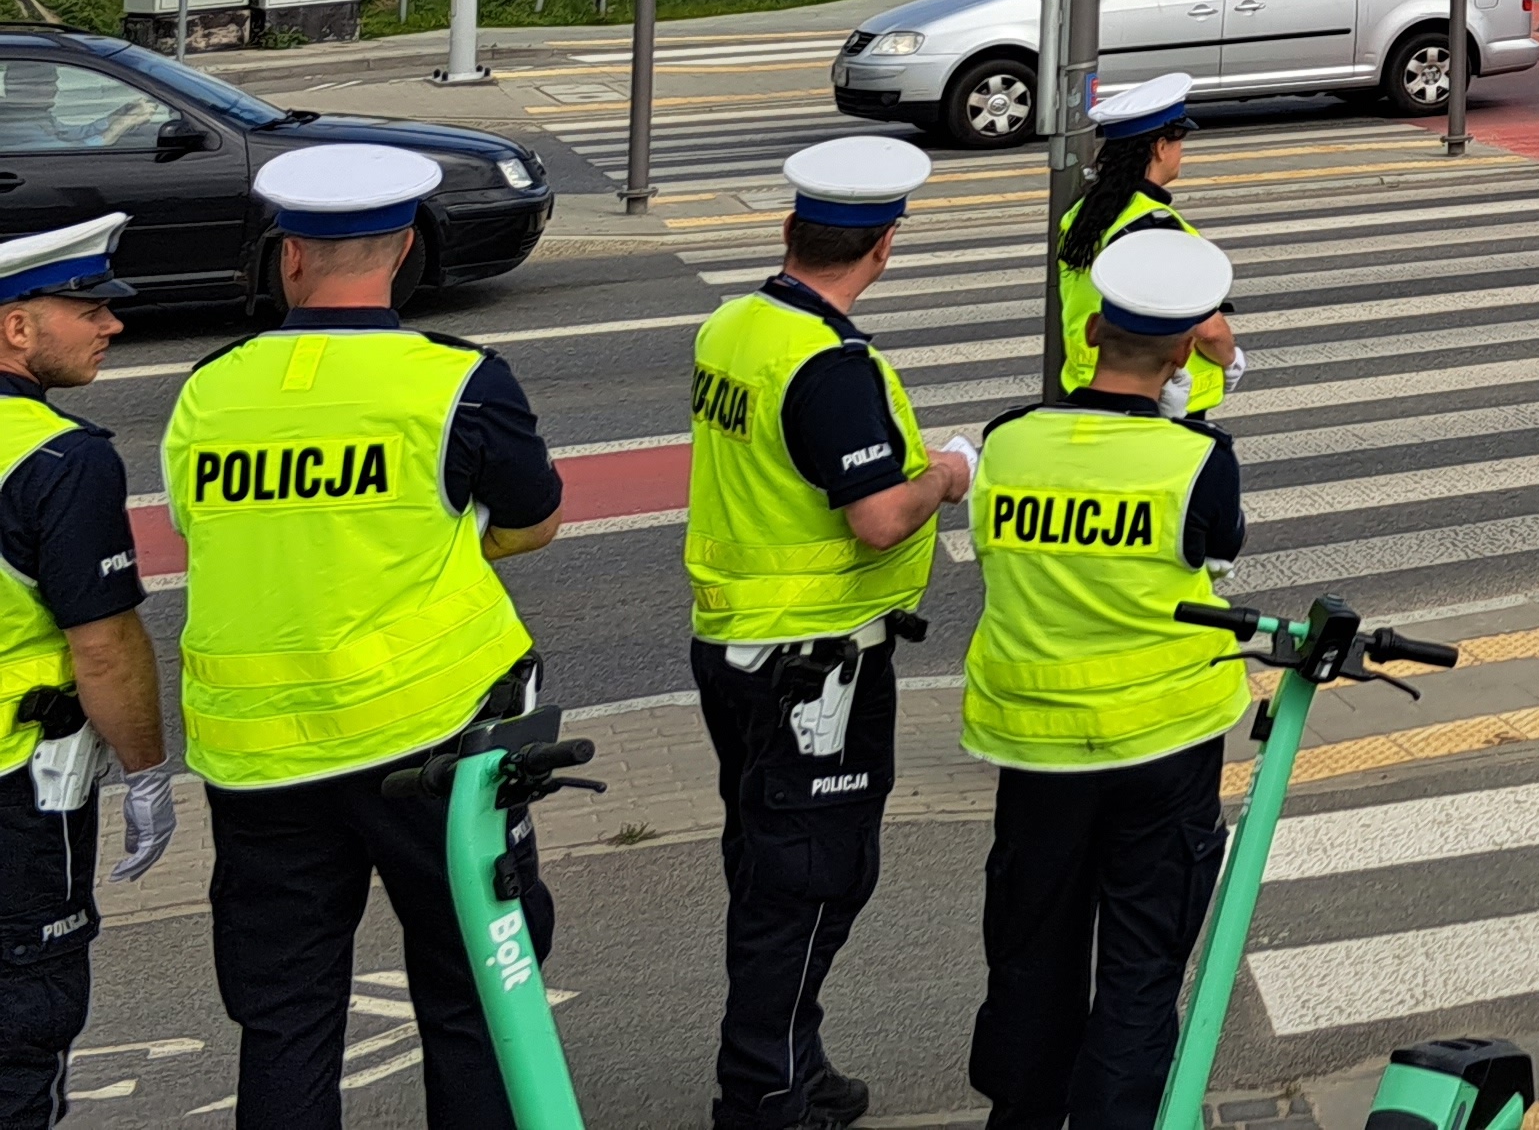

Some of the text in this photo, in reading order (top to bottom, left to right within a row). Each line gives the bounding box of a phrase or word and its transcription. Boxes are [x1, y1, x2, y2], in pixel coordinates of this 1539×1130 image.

[195, 444, 388, 503] POLICJA
[993, 495, 1152, 547] POLICJA
[812, 772, 869, 797] POLICJA
[486, 910, 533, 992] Bolt
